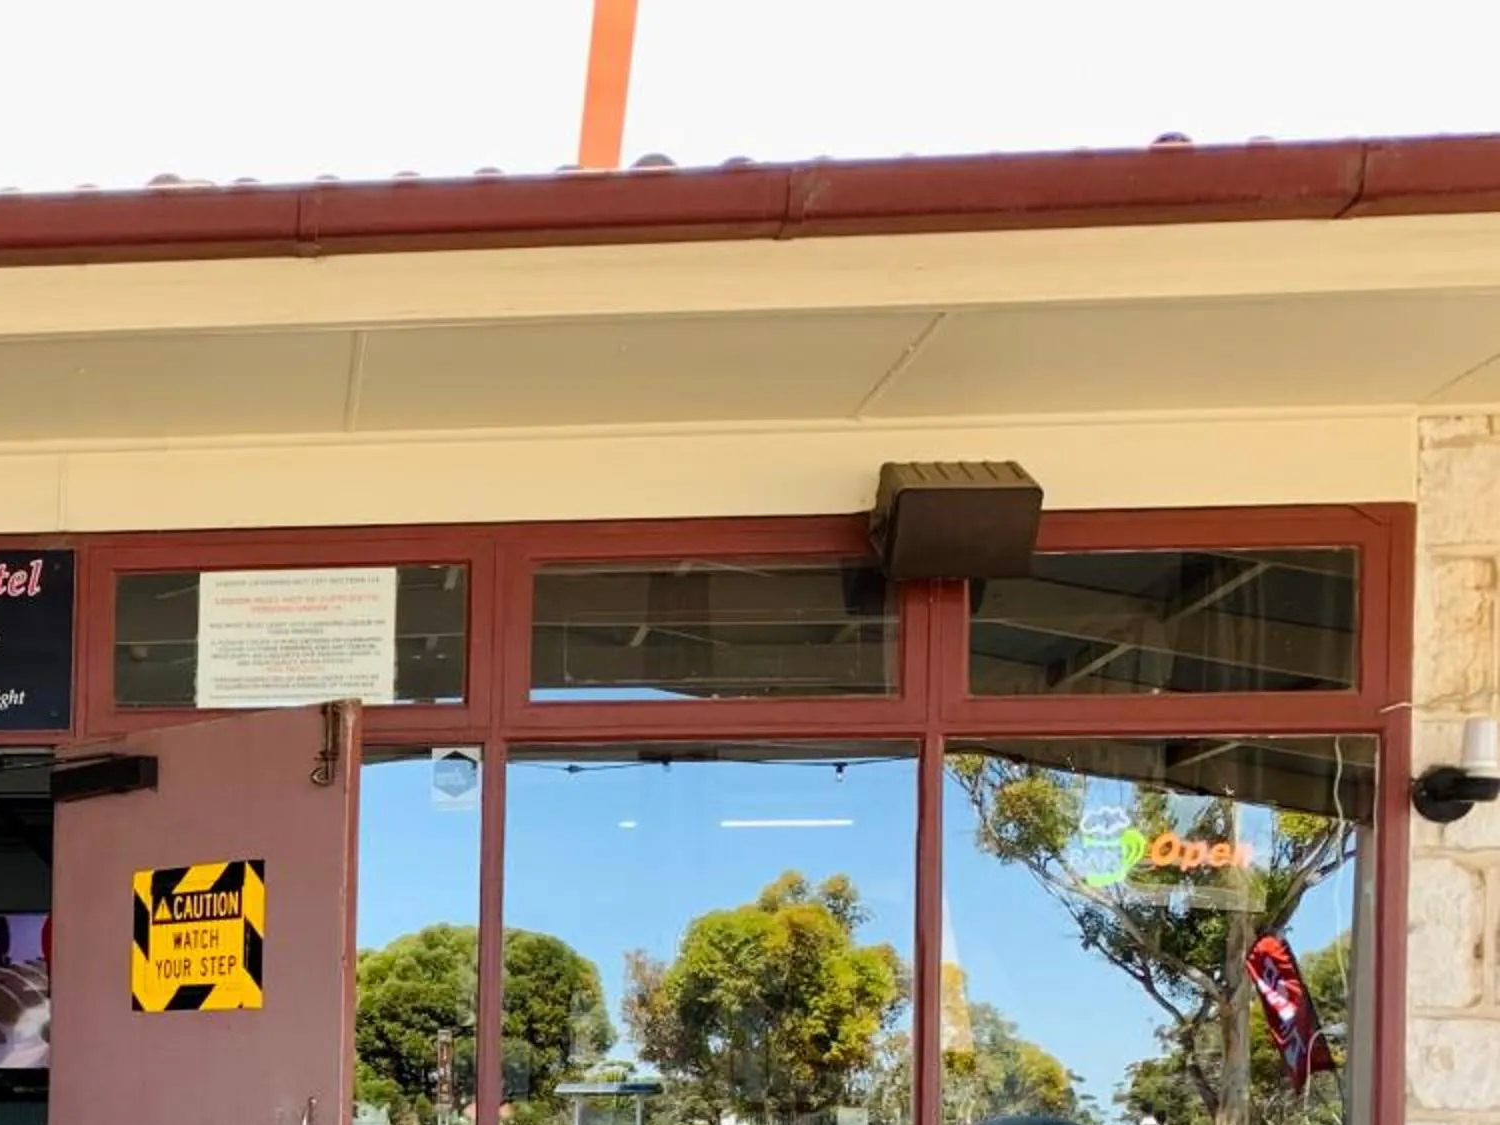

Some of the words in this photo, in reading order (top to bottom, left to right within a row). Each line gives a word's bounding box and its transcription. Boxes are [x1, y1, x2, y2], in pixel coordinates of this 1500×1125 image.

[1151, 832, 1253, 871] Open
[173, 891, 239, 920] CAUTION
[172, 929, 220, 949] WATCH
[155, 958, 192, 979] YOUR
[199, 955, 237, 977] STEP
